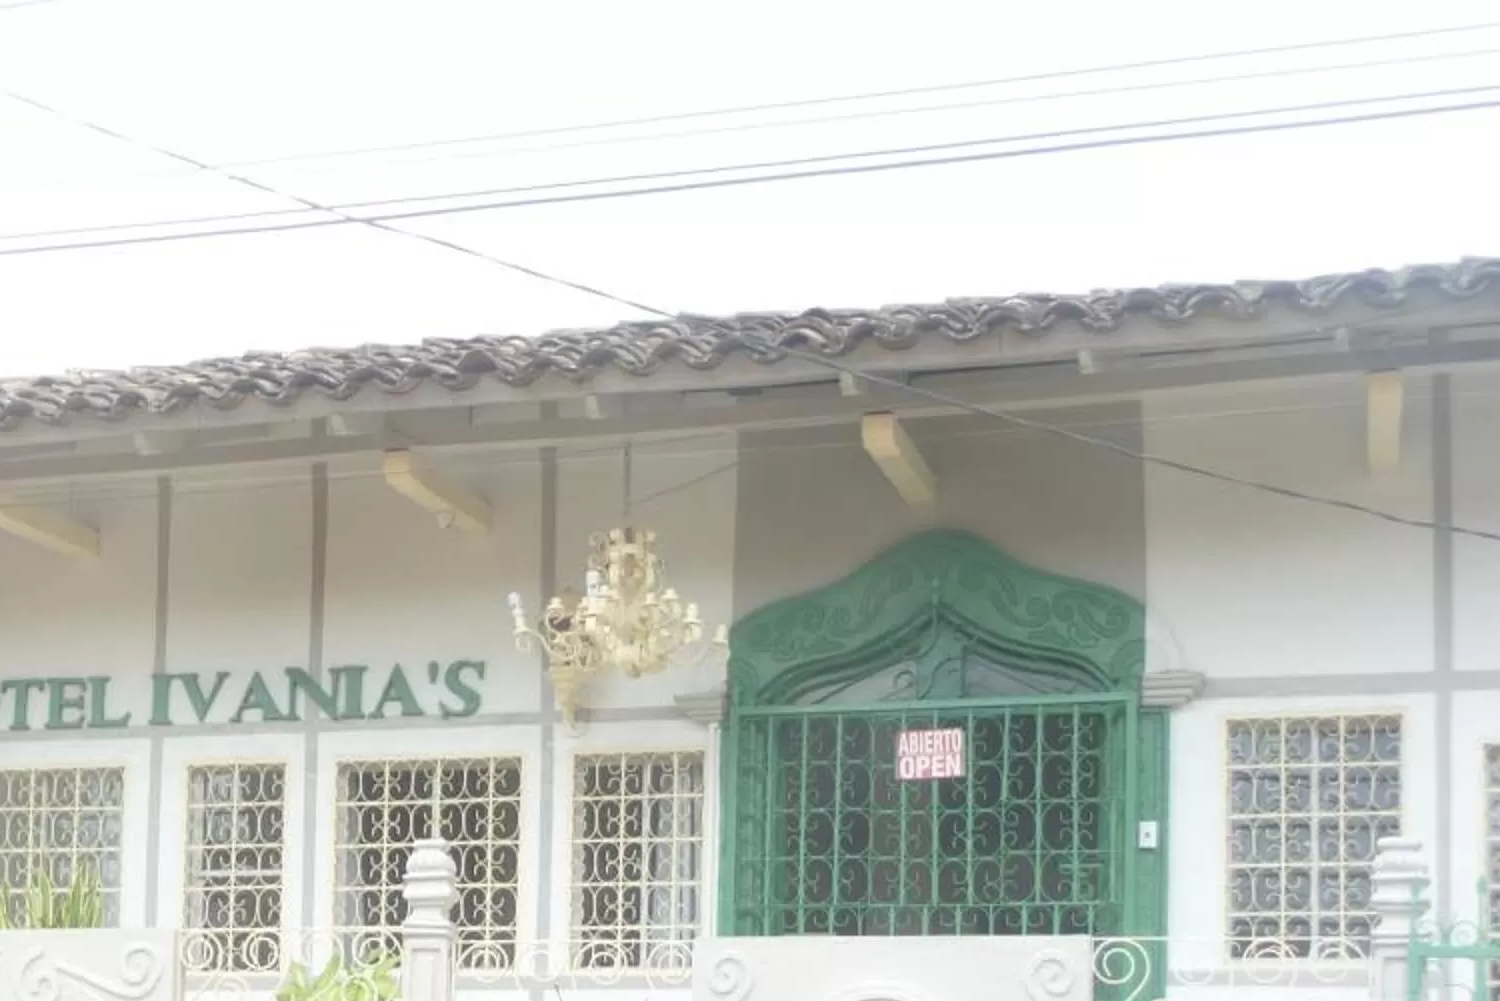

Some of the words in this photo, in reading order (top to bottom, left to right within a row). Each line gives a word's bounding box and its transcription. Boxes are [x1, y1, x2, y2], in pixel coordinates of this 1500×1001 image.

[147, 660, 485, 726] IVANIA'S
[898, 728, 962, 756] ABIERTO
[900, 754, 961, 779] OPEN
